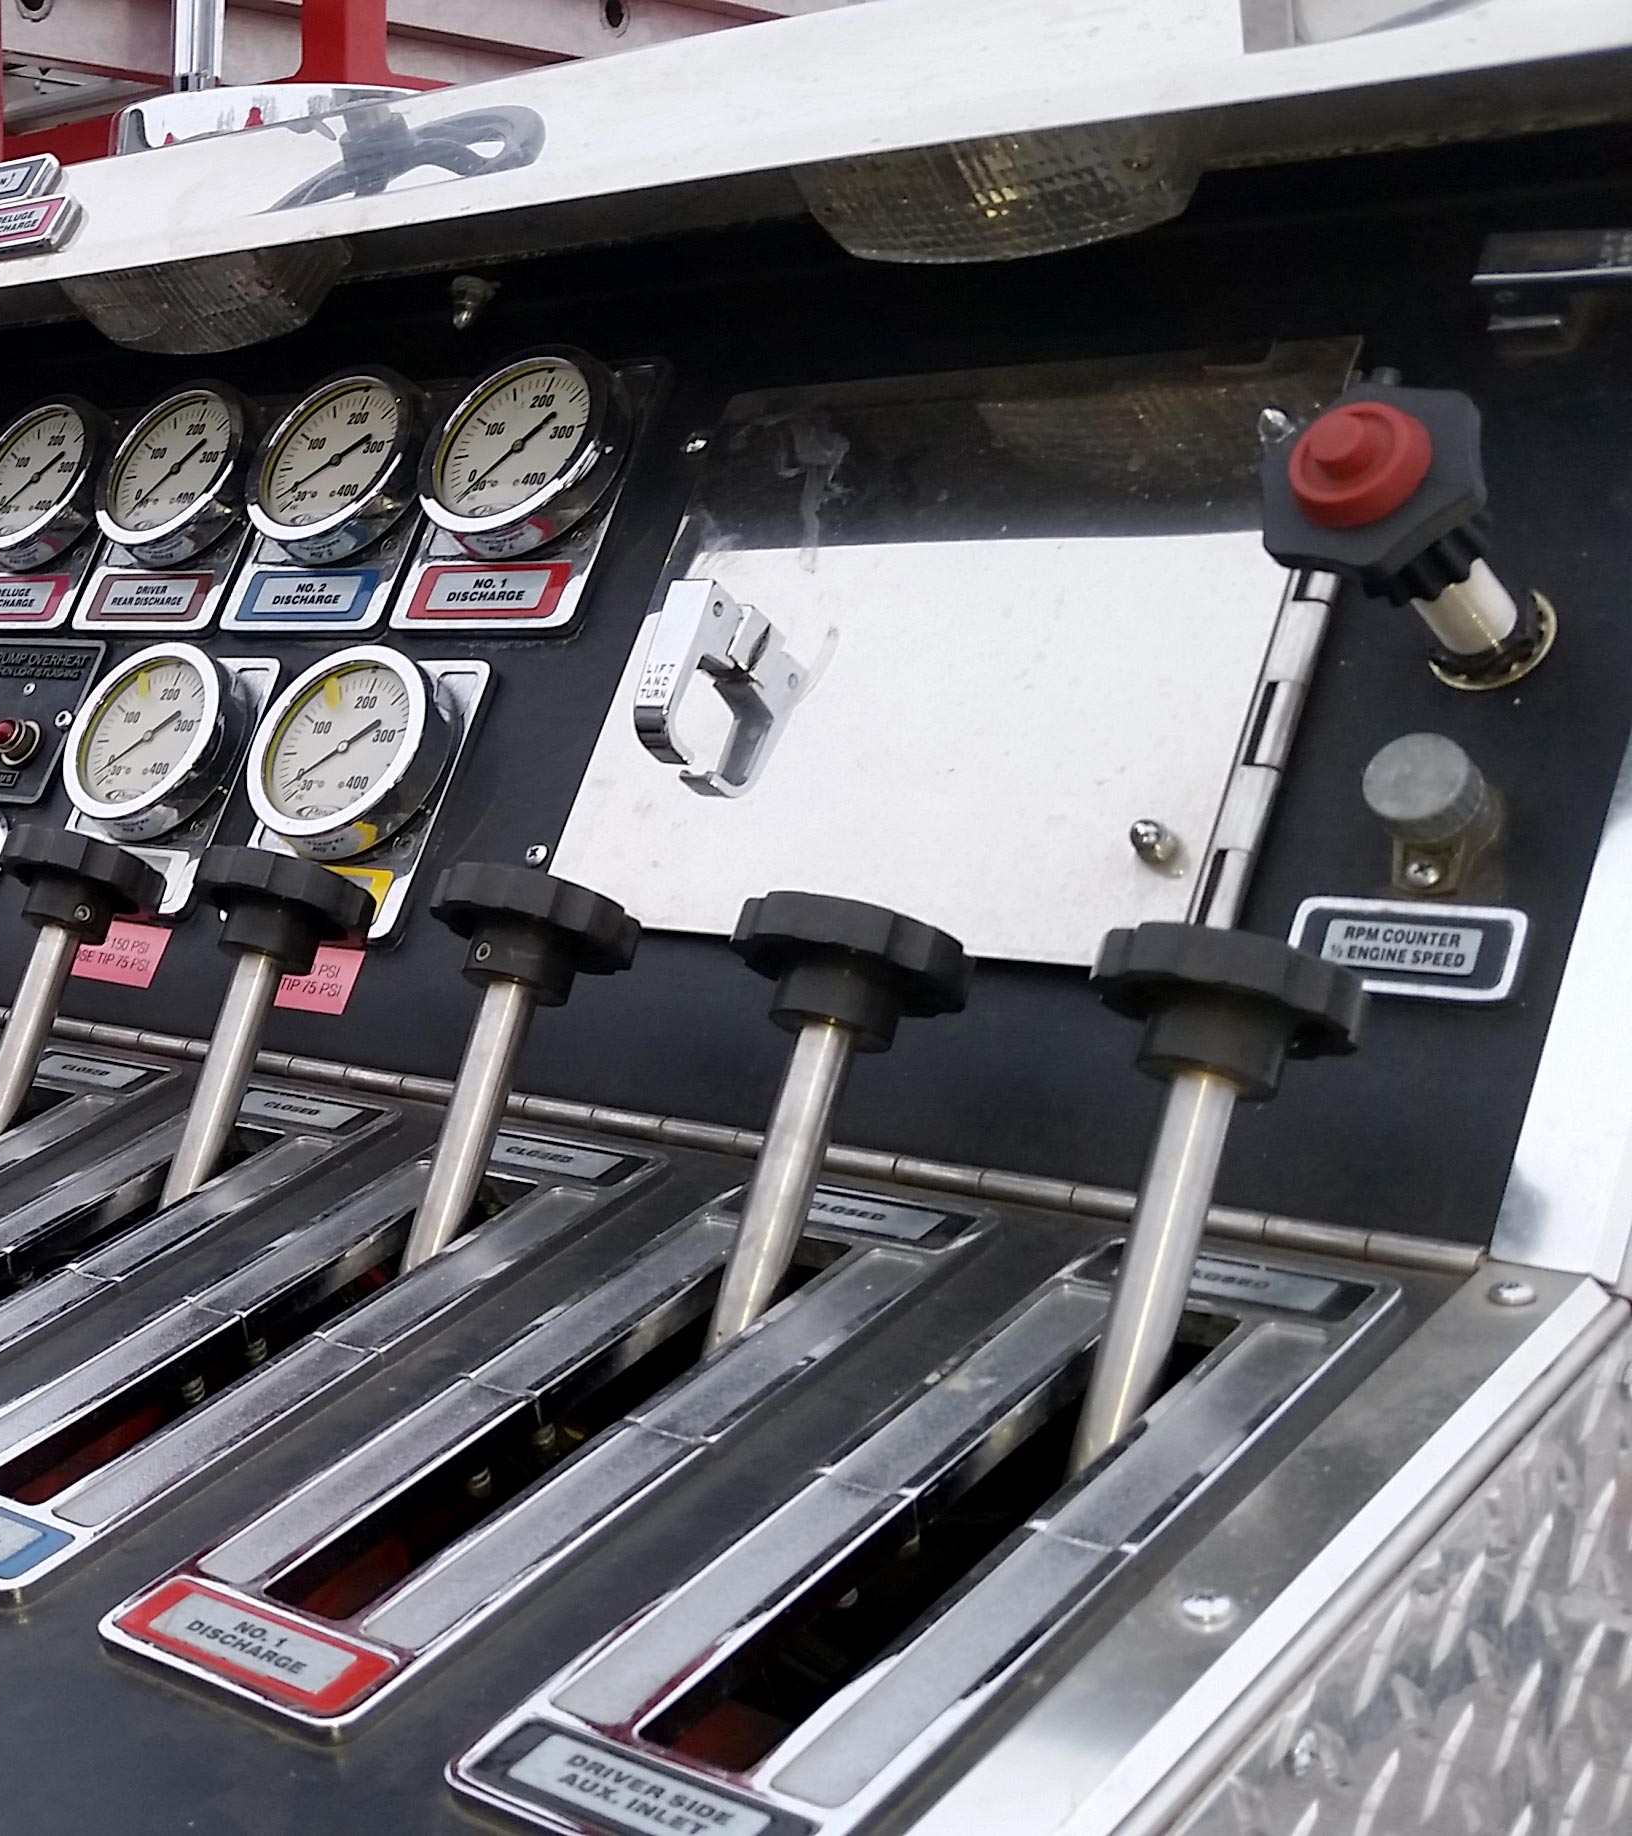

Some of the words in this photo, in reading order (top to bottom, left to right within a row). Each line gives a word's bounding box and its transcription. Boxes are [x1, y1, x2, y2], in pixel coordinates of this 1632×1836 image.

[530, 394, 555, 408] 200
[347, 412, 369, 425] 200
[186, 423, 206, 435] 200
[485, 421, 505, 435] 100
[550, 426, 575, 439] 300
[47, 434, 65, 447] 200
[307, 438, 326, 450] 100
[363, 441, 385, 453] 300
[150, 447, 167, 459] 100
[199, 451, 218, 463] 300
[15, 457, 31, 469] 100
[57, 461, 75, 473] 300
[468, 469, 476, 482] 0
[521, 472, 546, 486] 400
[135, 489, 142, 501] 0
[337, 484, 358, 497] 400
[176, 492, 195, 504] 400
[34, 499, 53, 511] 400
[136, 585, 168, 595] DRIVER
[295, 583, 318, 593] NO.
[319, 583, 327, 593] 2
[472, 578, 498, 590] NO.
[500, 578, 507, 589] 1
[110, 595, 134, 606] REAR
[134, 596, 184, 606] DISCHARGE
[272, 594, 342, 605] DISCHARGE
[446, 590, 525, 602] DISCHARGE
[28, 653, 91, 668] OVERHEAT
[647, 664, 675, 674] LIFT
[644, 677, 669, 686] AND
[160, 687, 182, 701] 200
[640, 689, 667, 699] TURN
[354, 695, 377, 710] 200
[123, 711, 142, 724] 100
[173, 719, 195, 732] 300
[312, 722, 331, 735] 100
[372, 729, 396, 743] 300
[149, 763, 170, 776] 400
[346, 776, 369, 790] 400
[1344, 926, 1379, 941] RPM
[1382, 929, 1461, 947] COUNTER
[111, 938, 128, 951] 150
[130, 940, 150, 954] PSI
[97, 952, 115, 966] TIP
[115, 956, 128, 969] 75
[130, 958, 150, 972] PSI
[1347, 946, 1406, 964] ENGINE
[1411, 950, 1465, 968] SPEED
[318, 964, 341, 979] PSI
[280, 977, 300, 992] TIP
[303, 980, 317, 995] 75
[320, 983, 342, 998] PSI
[61, 1063, 110, 1077] CLOSED
[263, 1101, 320, 1116] CLOSED
[506, 1146, 574, 1164] CLOSED
[233, 1620, 271, 1642] NO.
[275, 1637, 288, 1648] 1
[186, 1619, 308, 1674] DISCHARGE
[566, 1754, 667, 1800] DRIVER
[673, 1794, 737, 1827] SIDE
[557, 1773, 618, 1805] AUX.
[625, 1798, 710, 1836] INLET
